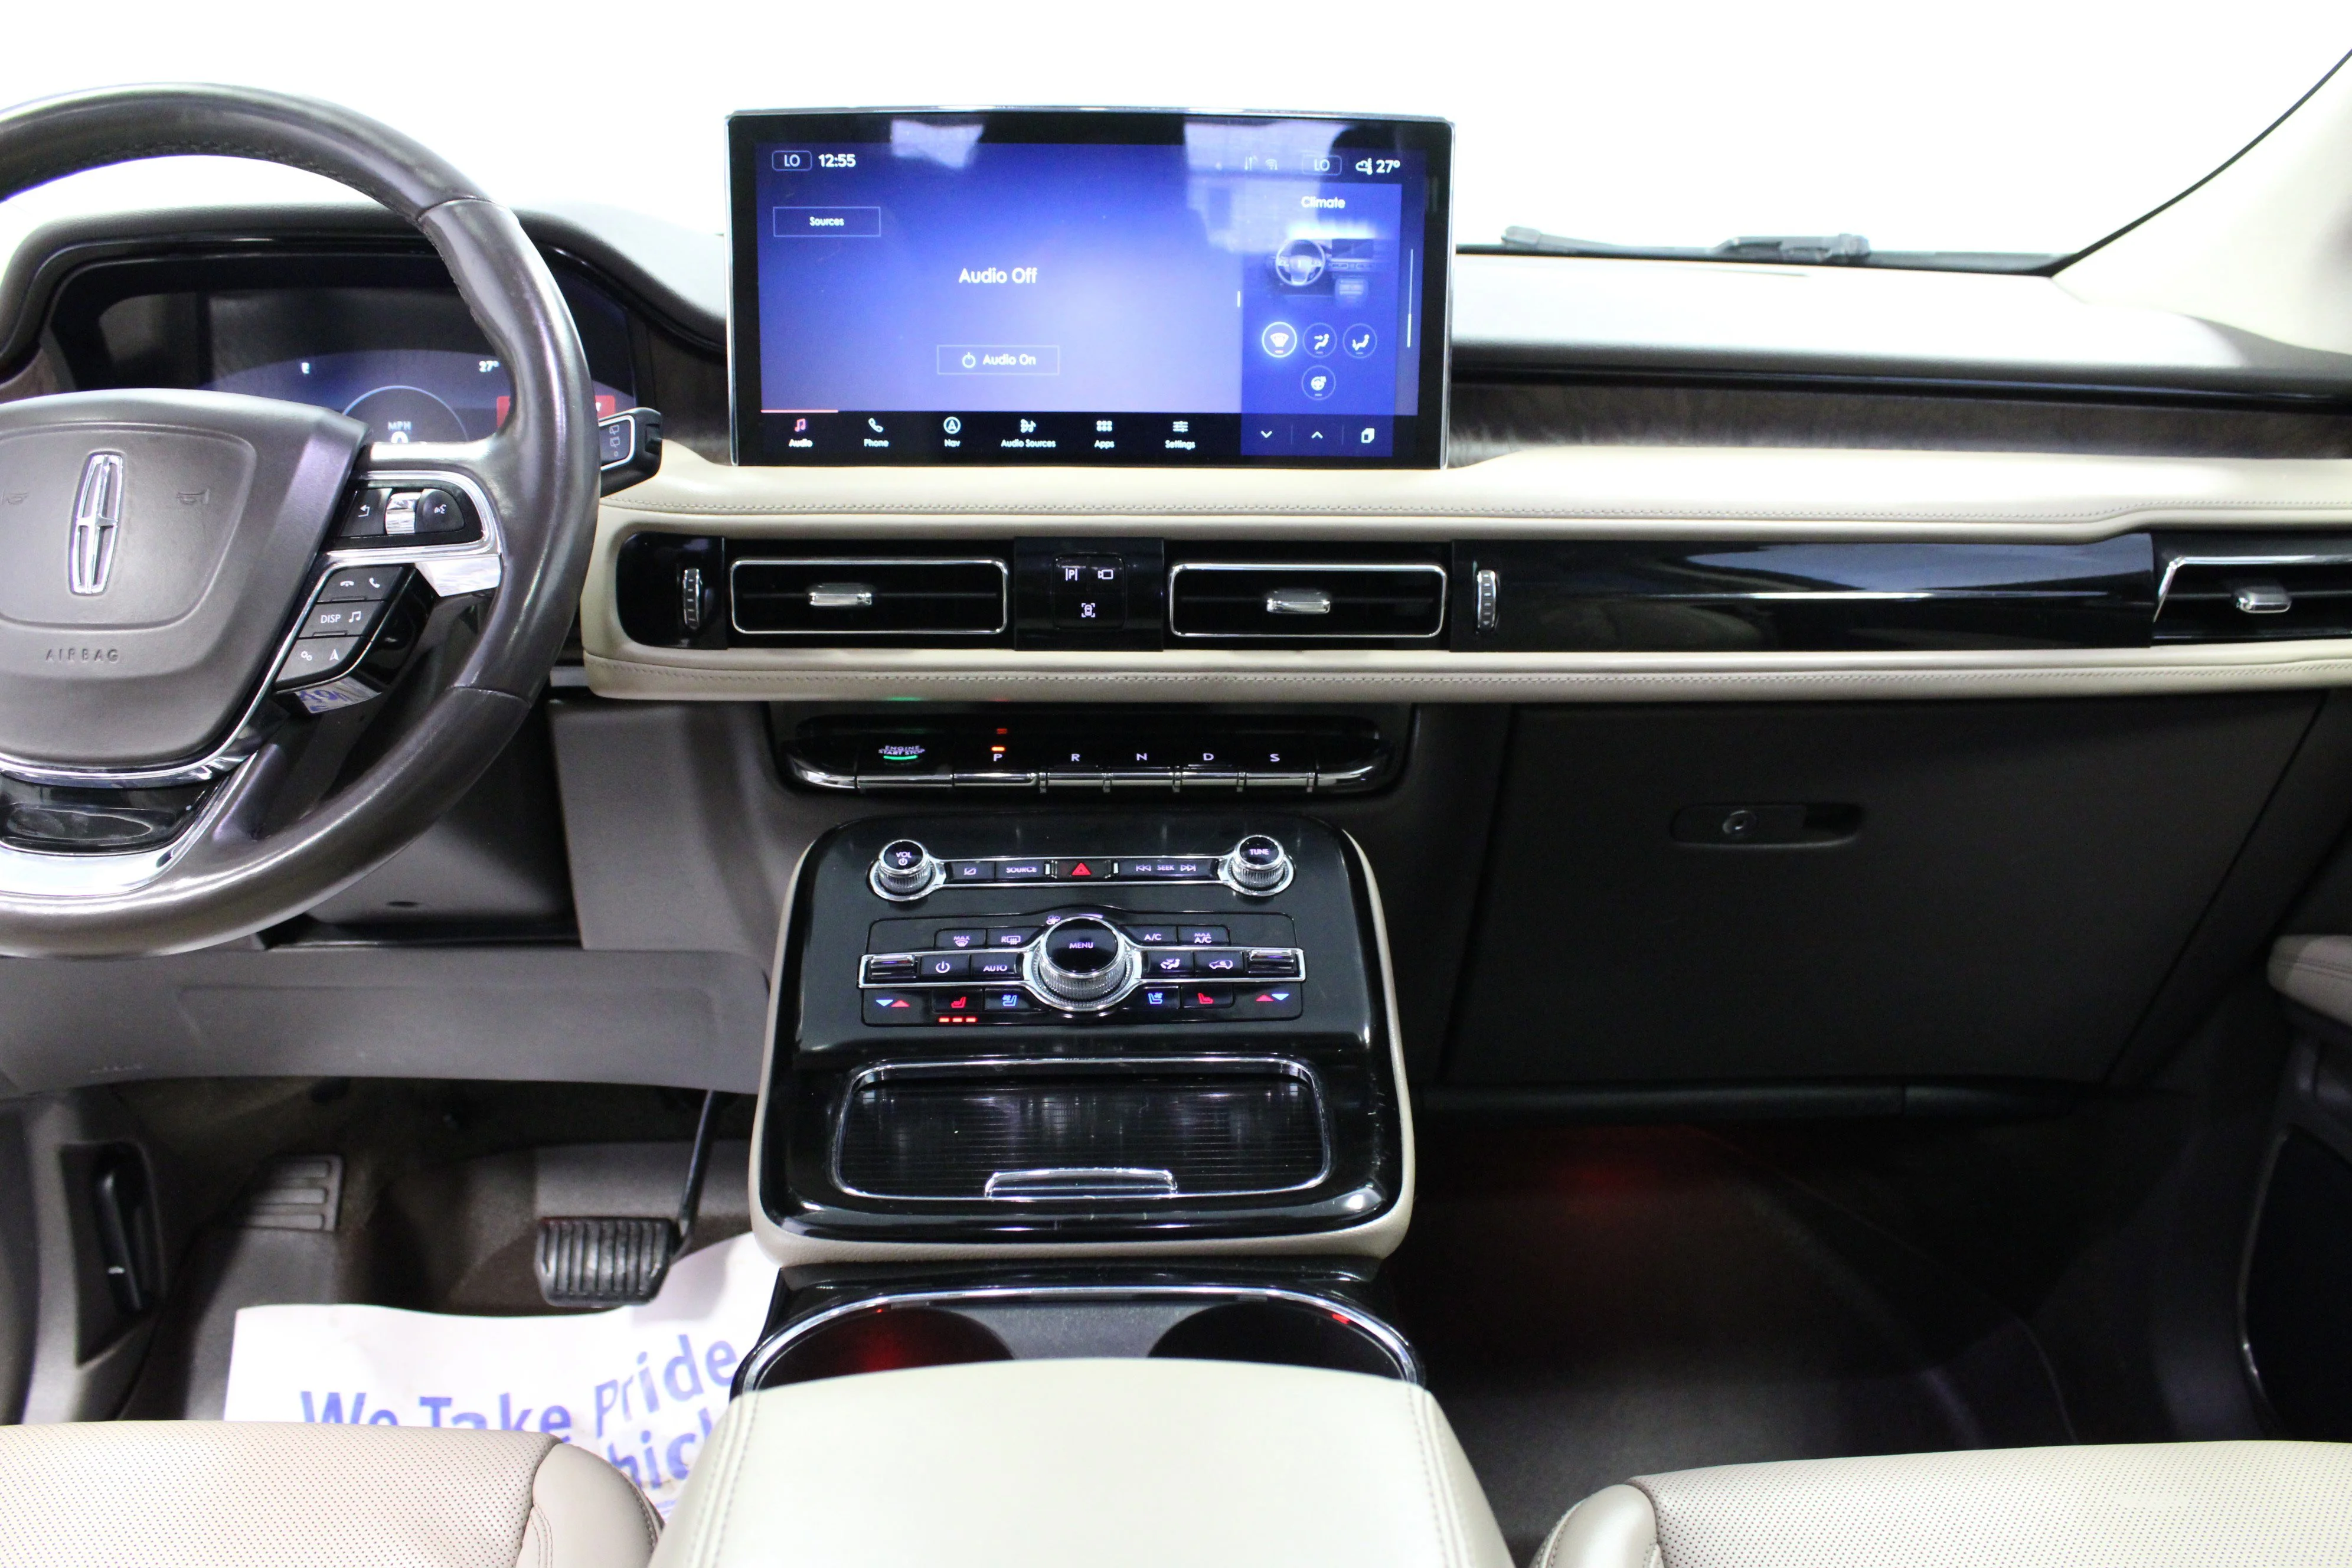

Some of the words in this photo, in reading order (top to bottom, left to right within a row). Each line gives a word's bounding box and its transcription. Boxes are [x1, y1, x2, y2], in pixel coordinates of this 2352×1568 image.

[784, 154, 801, 167] LO
[818, 153, 856, 168] 12:55
[1314, 158, 1330, 172] LO
[1376, 159, 1401, 174] 27°
[1301, 195, 1345, 209] Climate
[809, 216, 845, 227] Sources
[958, 267, 1008, 284] Audio
[1011, 267, 1038, 284] Off
[982, 354, 1017, 366] Audio
[1018, 354, 1037, 366] On
[479, 360, 499, 373] 27°
[387, 421, 411, 430] MPH
[788, 438, 813, 447] Audio
[864, 438, 889, 447] Phone
[944, 439, 961, 447] Nav
[1001, 439, 1025, 447] Audio
[1026, 439, 1056, 448] Sources
[1094, 439, 1115, 450] Apps
[1165, 439, 1197, 450] Settings
[320, 614, 341, 624] DISP
[45, 648, 119, 662] AIRBAG
[993, 753, 1002, 762] P
[1071, 753, 1080, 762] R
[1136, 753, 1148, 761] N
[1203, 753, 1214, 761] D
[1270, 753, 1280, 762] S
[594, 1334, 738, 1439] Pride
